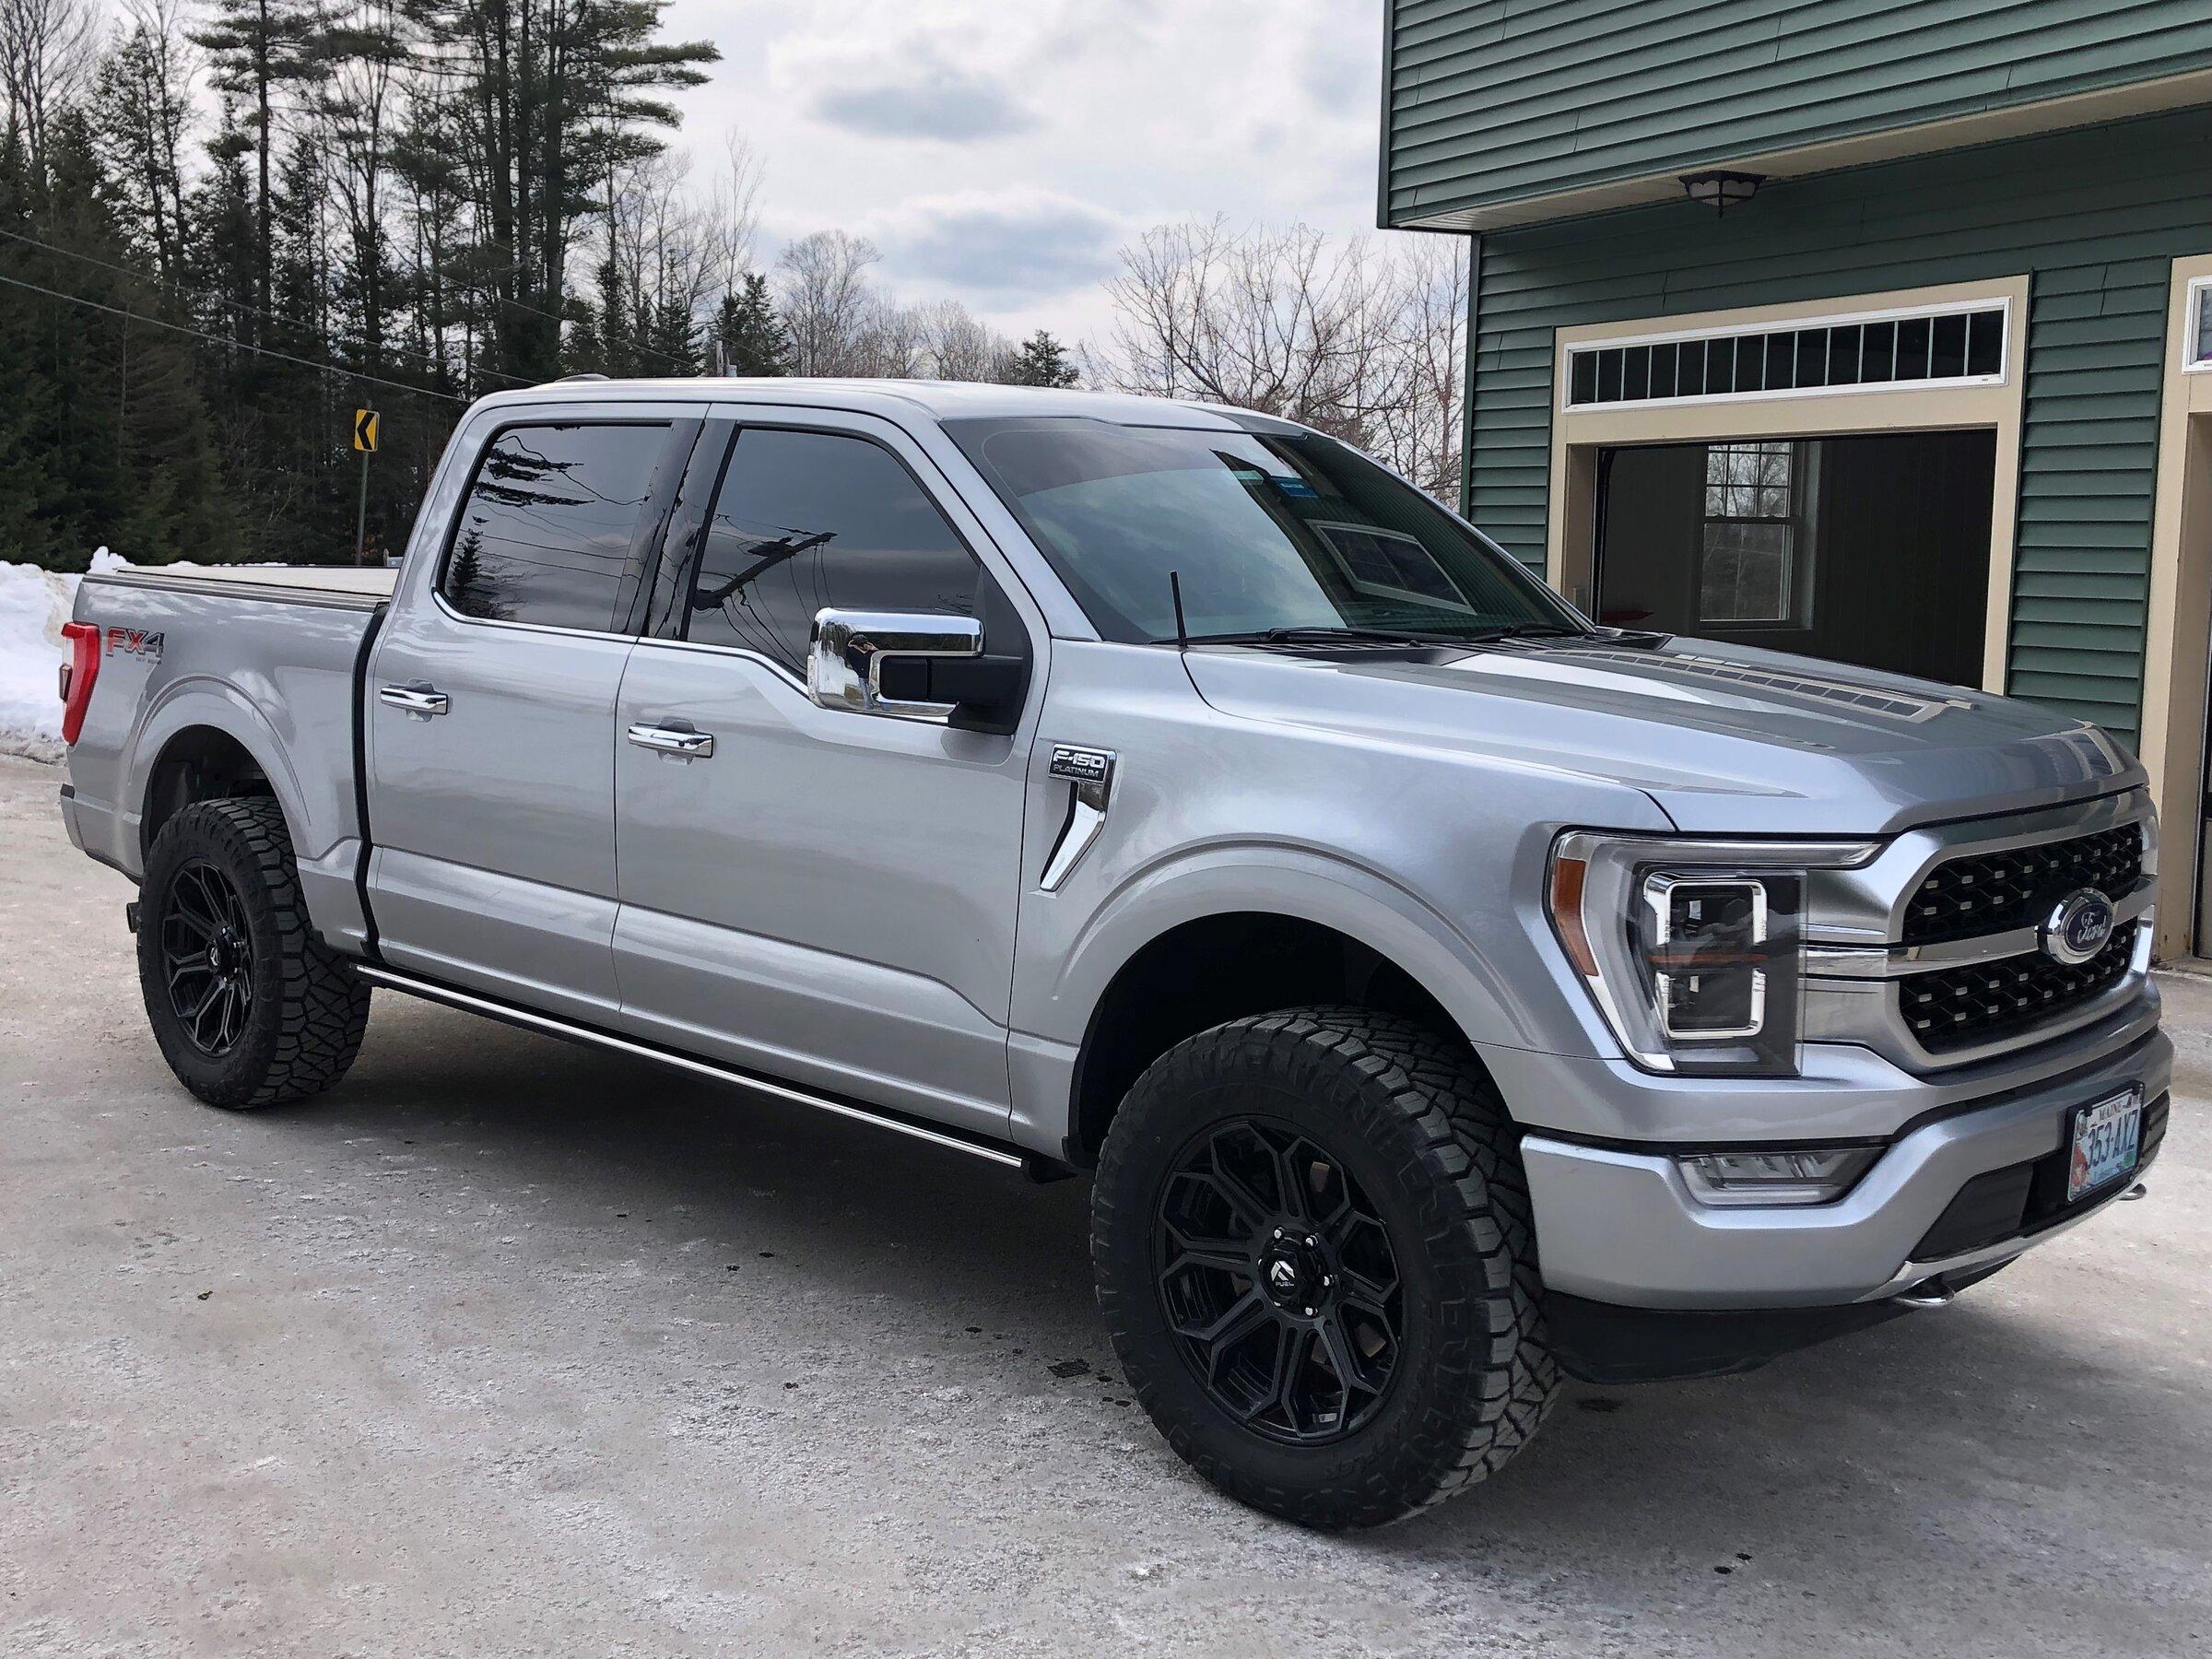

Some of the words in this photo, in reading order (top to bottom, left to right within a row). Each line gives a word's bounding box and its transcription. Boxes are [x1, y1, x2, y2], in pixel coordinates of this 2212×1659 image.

[106, 626, 165, 657] FX4
[1053, 749, 1106, 769] F-150
[1053, 764, 1100, 777] PLATINUM
[2077, 911, 2107, 944] Ford
